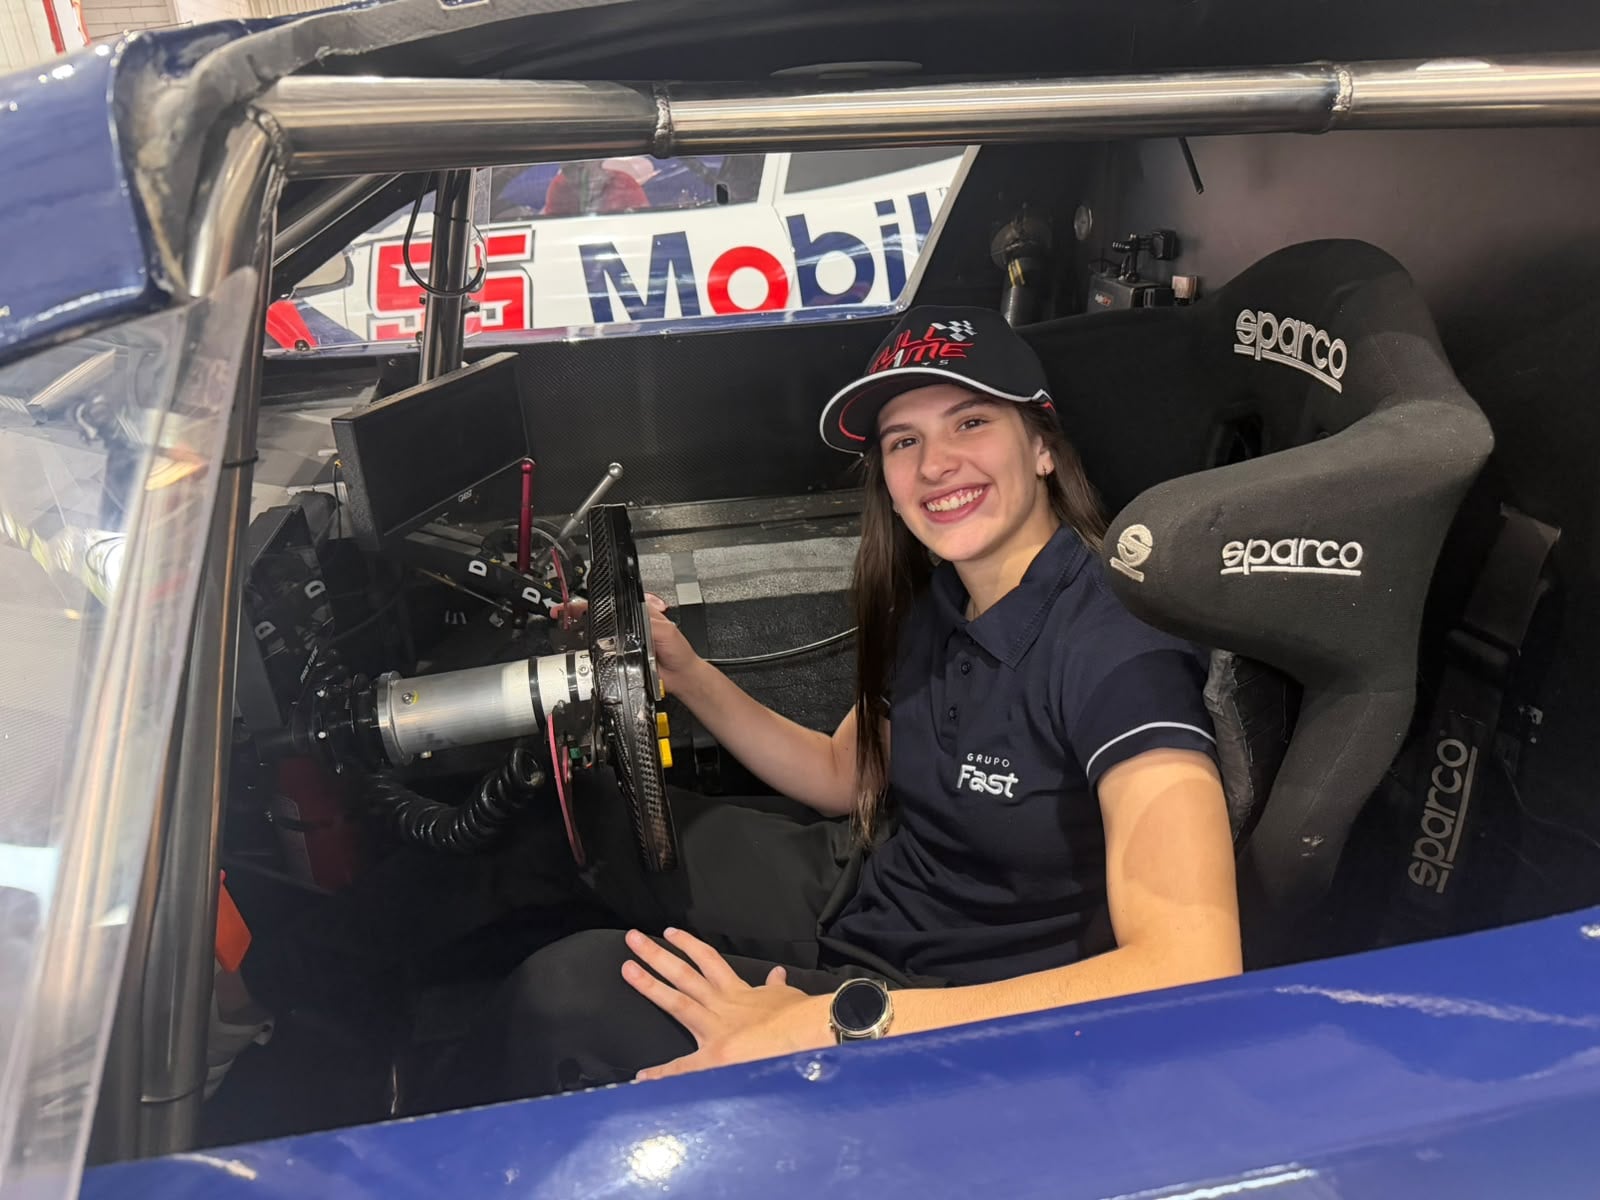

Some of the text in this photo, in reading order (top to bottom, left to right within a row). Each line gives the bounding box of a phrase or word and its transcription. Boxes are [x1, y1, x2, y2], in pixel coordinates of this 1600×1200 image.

[1234, 309, 1347, 390] sparco
[1221, 538, 1363, 575] sparco
[966, 752, 1010, 768] GRUPO
[957, 764, 1019, 798] Fast
[1407, 738, 1475, 893] sparco
